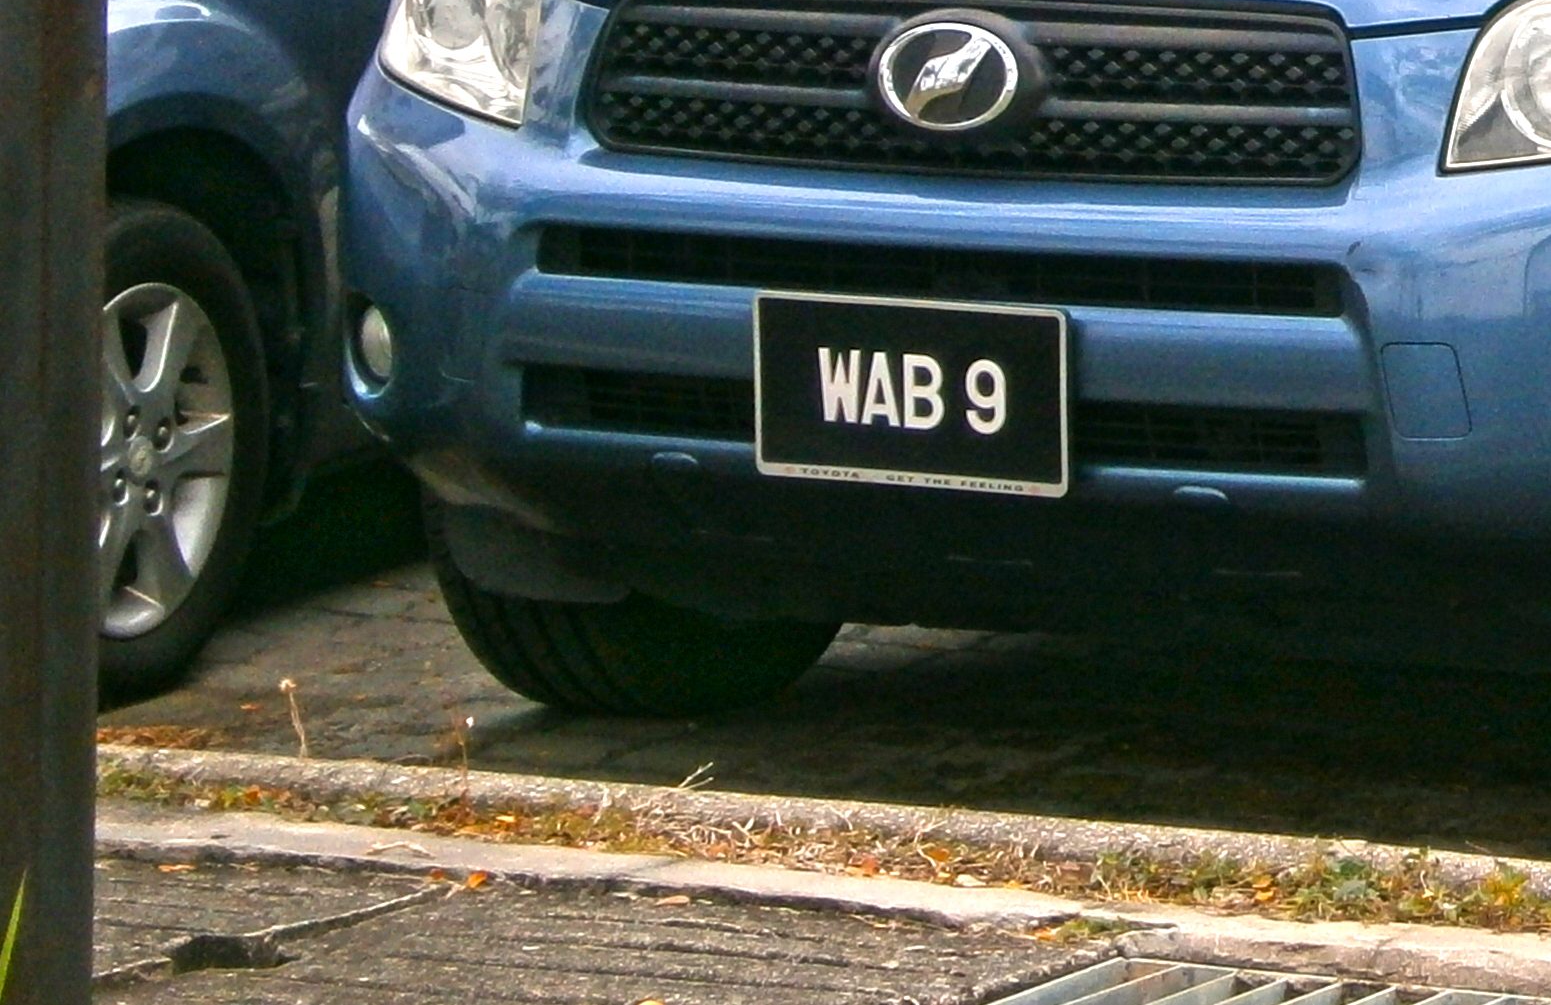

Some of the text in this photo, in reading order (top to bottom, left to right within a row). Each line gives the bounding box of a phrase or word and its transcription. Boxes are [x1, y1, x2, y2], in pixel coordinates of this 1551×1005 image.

[817, 346, 1007, 435] WAB 9
[799, 467, 1025, 492] TOYOTA GET THE FEELING
